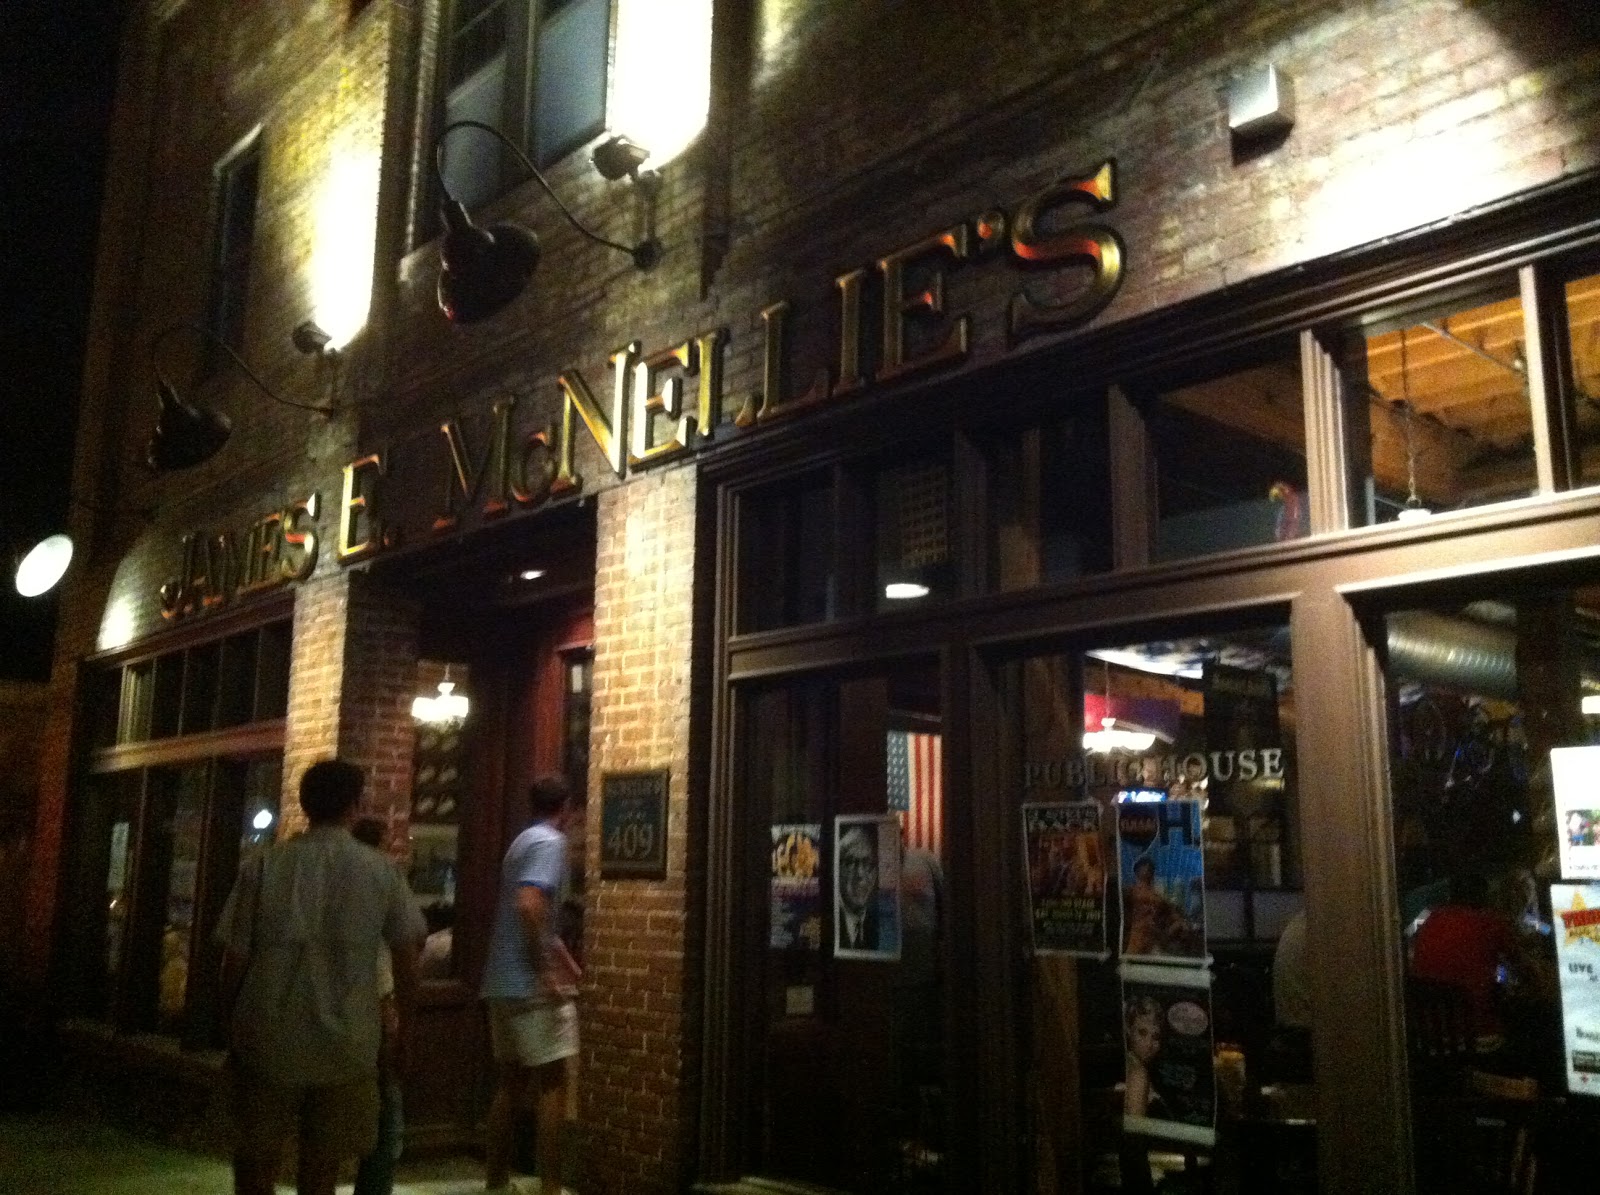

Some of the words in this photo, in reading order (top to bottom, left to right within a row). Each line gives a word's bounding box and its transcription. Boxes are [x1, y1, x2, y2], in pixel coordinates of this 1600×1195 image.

[1023, 757, 1144, 789] PUBLIC
[1156, 748, 1285, 784] HOUSE
[606, 823, 654, 859] 409
